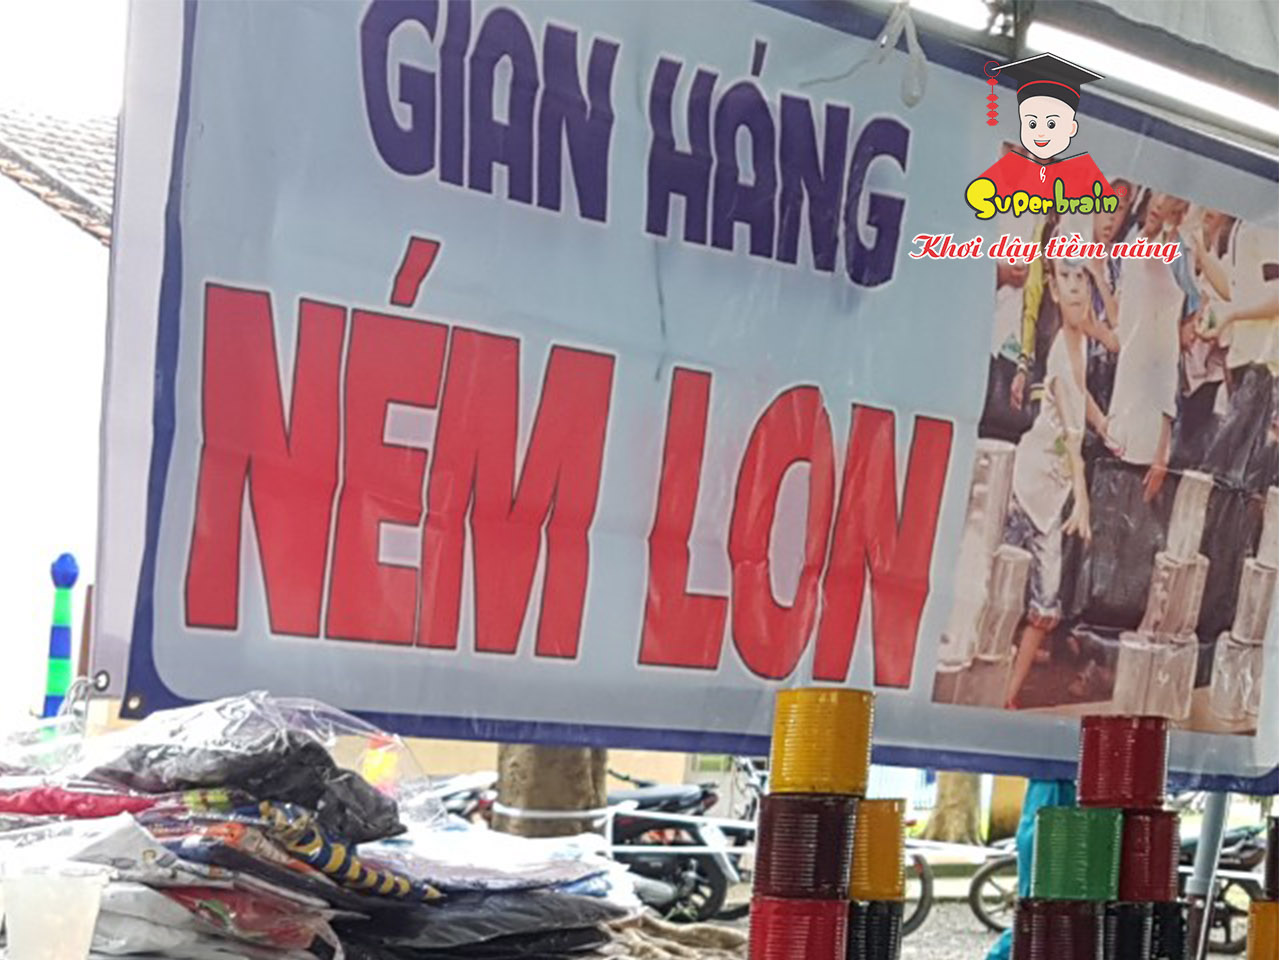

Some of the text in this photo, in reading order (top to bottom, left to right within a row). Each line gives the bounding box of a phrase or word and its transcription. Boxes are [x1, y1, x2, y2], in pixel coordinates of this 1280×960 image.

[360, 0, 621, 224] GIAN
[185, 237, 955, 689] NÉM LON
